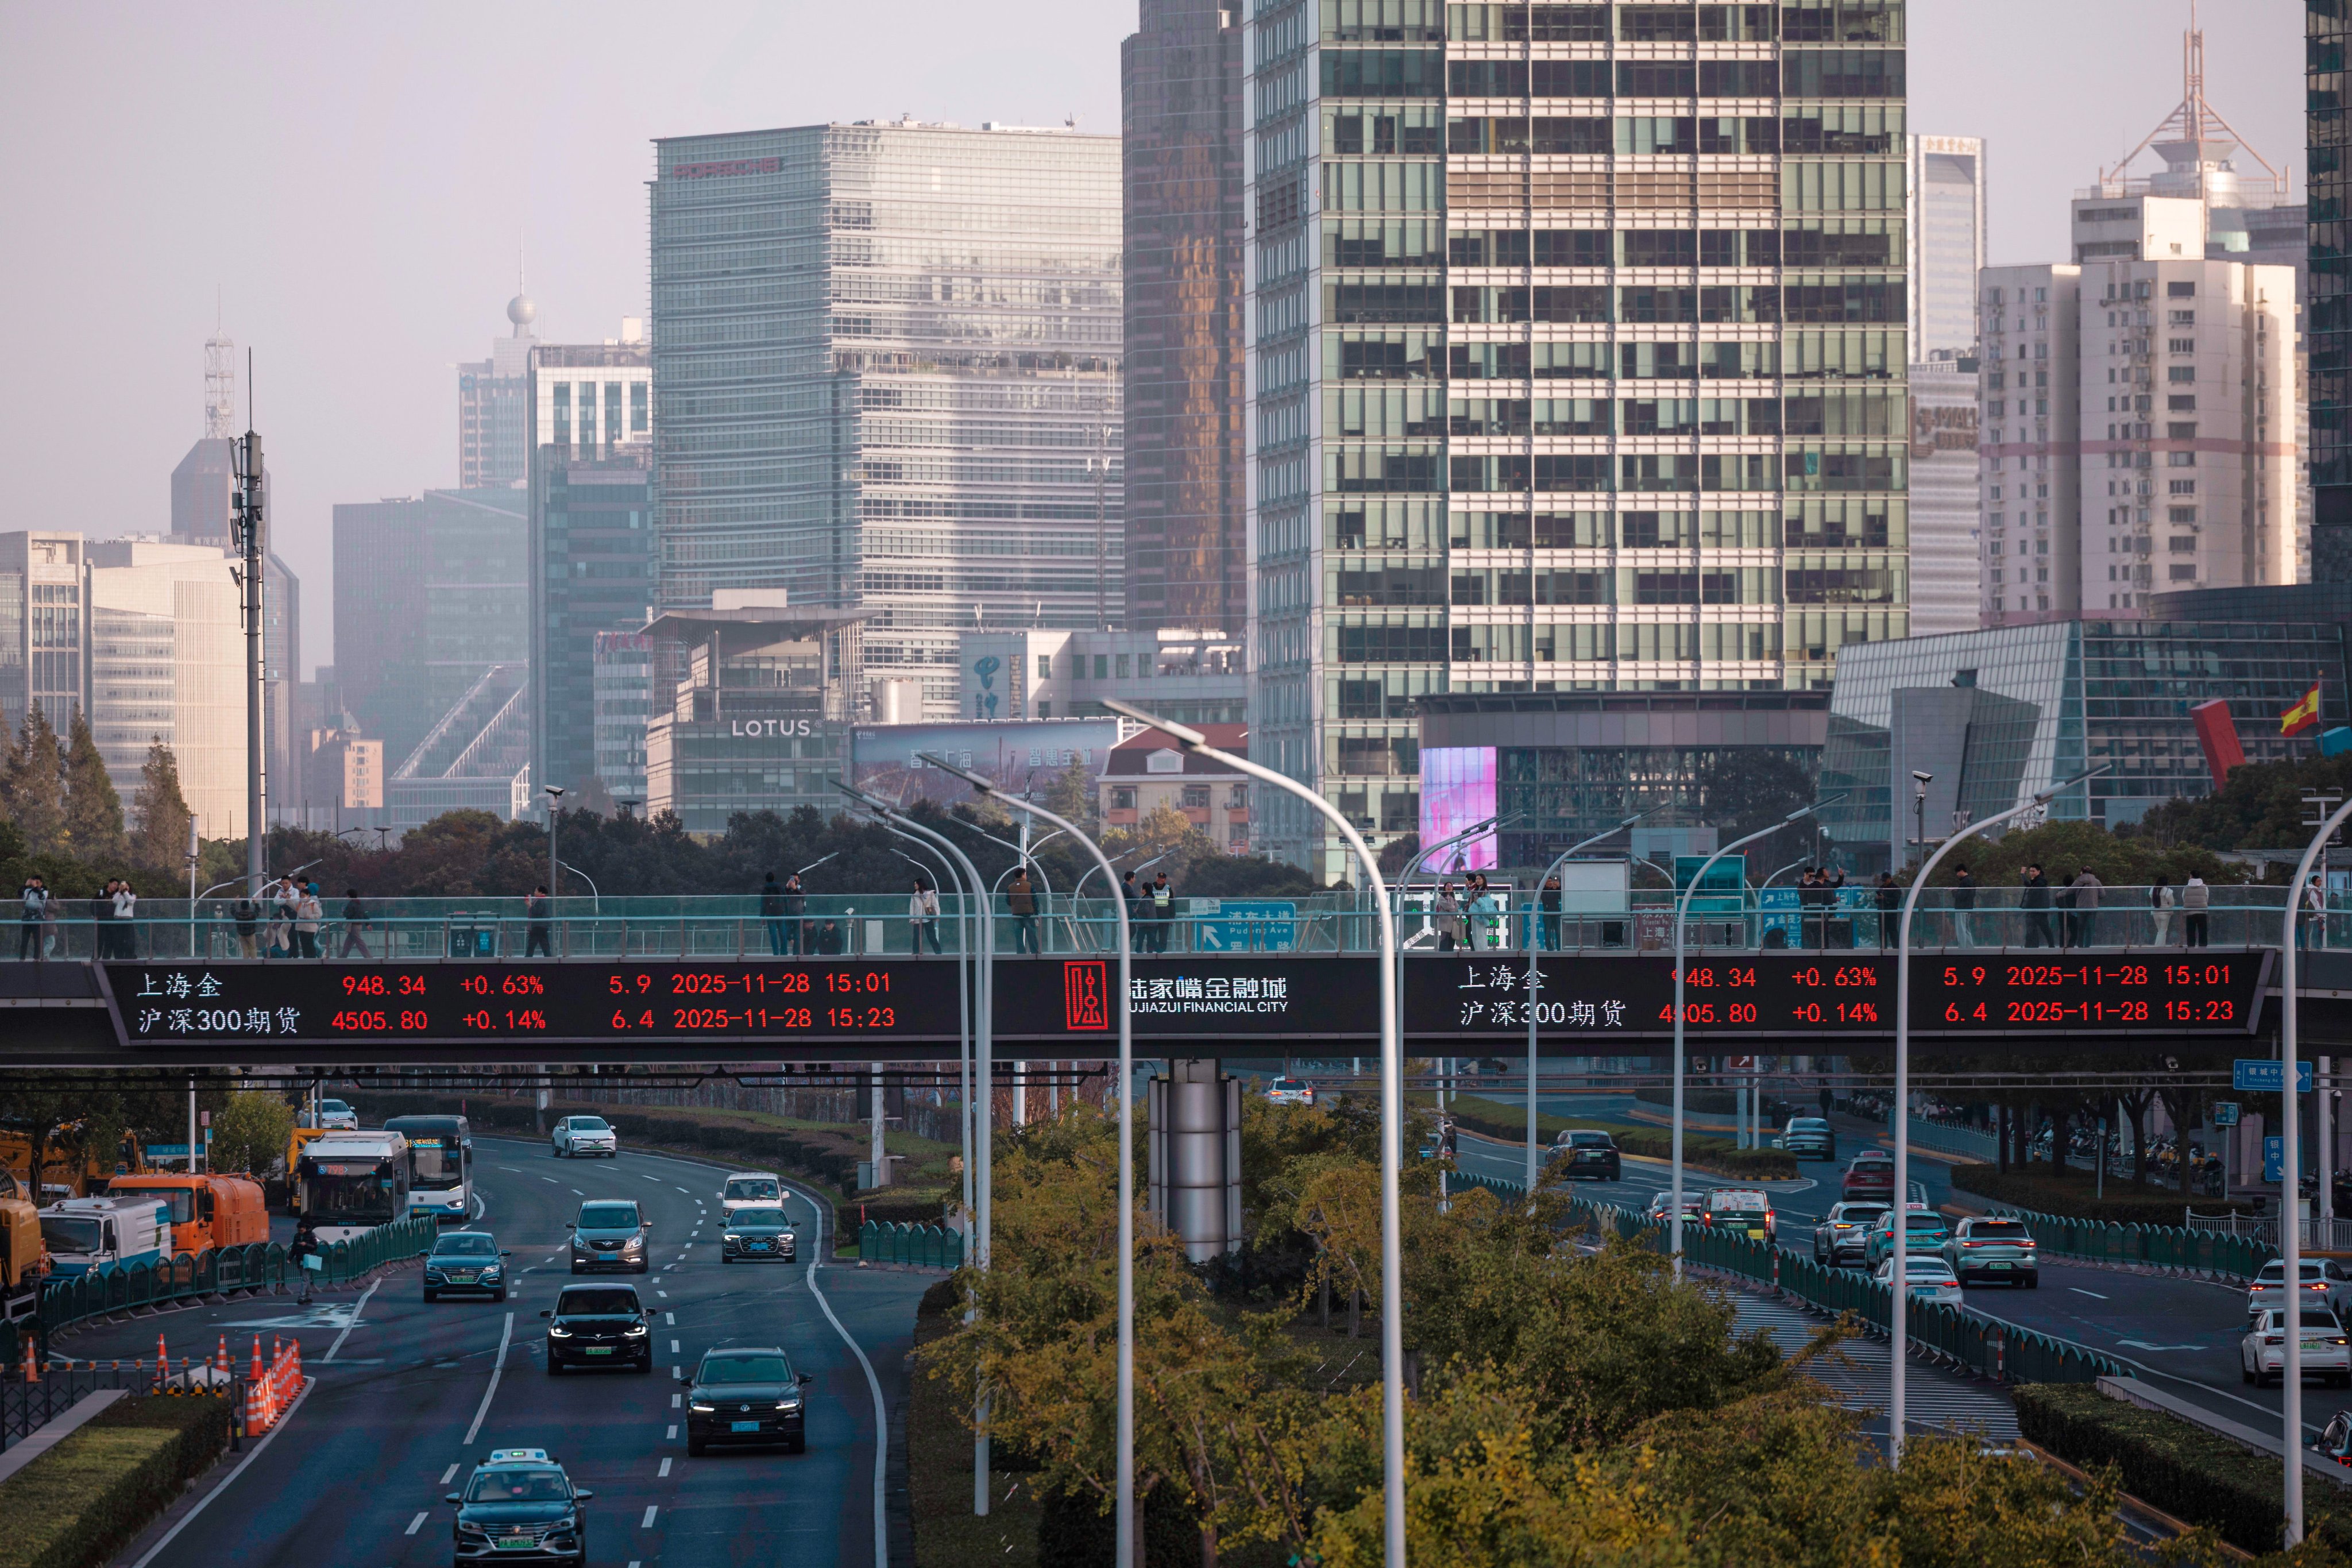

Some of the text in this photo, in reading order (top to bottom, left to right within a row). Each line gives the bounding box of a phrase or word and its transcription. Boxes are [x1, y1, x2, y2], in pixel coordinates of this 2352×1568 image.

[673, 157, 779, 179] PORSCHE
[732, 720, 810, 736] LOTUS
[137, 973, 223, 999] 上海金
[343, 973, 890, 995] 948.34 +0.63% 5.9 2025-11-28 15:01
[1458, 965, 1548, 991] 上海金
[1792, 967, 1876, 986] +0.63%
[1944, 967, 1986, 986] 5.9
[2007, 966, 2148, 985] 2025-11-28
[2165, 965, 2229, 985] 15:01
[1129, 976, 1287, 999] 陆家嘴金融城
[1129, 1001, 1288, 1013] UJIAZUI FINANCIAL CITY
[1461, 1000, 1626, 1027] 沪深300期货
[1793, 1003, 1878, 1022] +0.14%
[1945, 1002, 1987, 1022] 6.4
[2008, 1001, 2149, 1021] 2025-11-28
[2165, 1001, 2233, 1021] 15:23
[139, 1007, 300, 1033] 沪深300期货
[332, 1008, 895, 1030] 4505.80 +0.14% 6.4 2025-11-28 15:23
[2248, 1067, 2283, 1076] 银城中
[327, 1165, 344, 1176] 798
